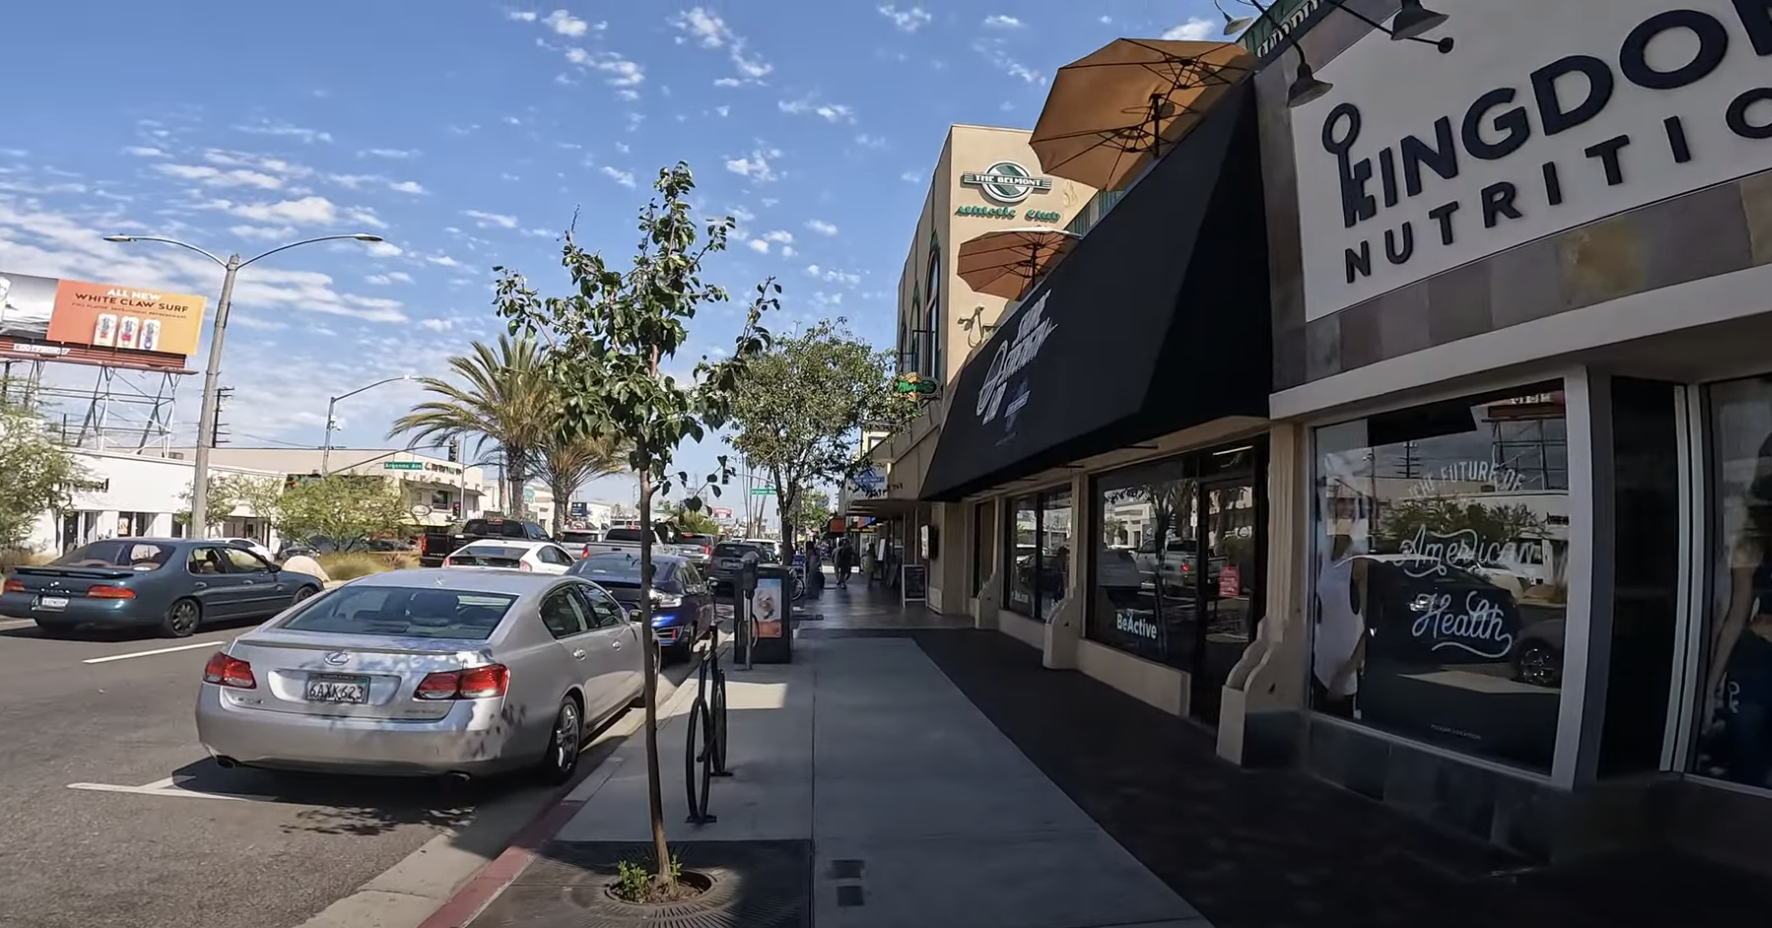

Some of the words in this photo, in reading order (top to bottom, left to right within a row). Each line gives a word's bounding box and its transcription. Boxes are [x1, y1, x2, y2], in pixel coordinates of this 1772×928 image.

[974, 174, 995, 183] THE
[996, 176, 1042, 187] BELMONT
[75, 293, 117, 305] WHITE
[120, 298, 155, 308] CLAW
[158, 303, 189, 313] SURF
[107, 288, 130, 298] ALL
[130, 291, 162, 301] NEW
[1397, 524, 1537, 578] American
[1115, 611, 1158, 641] BeActive
[1411, 590, 1514, 658] Health
[308, 683, 365, 700] 6AXK623
